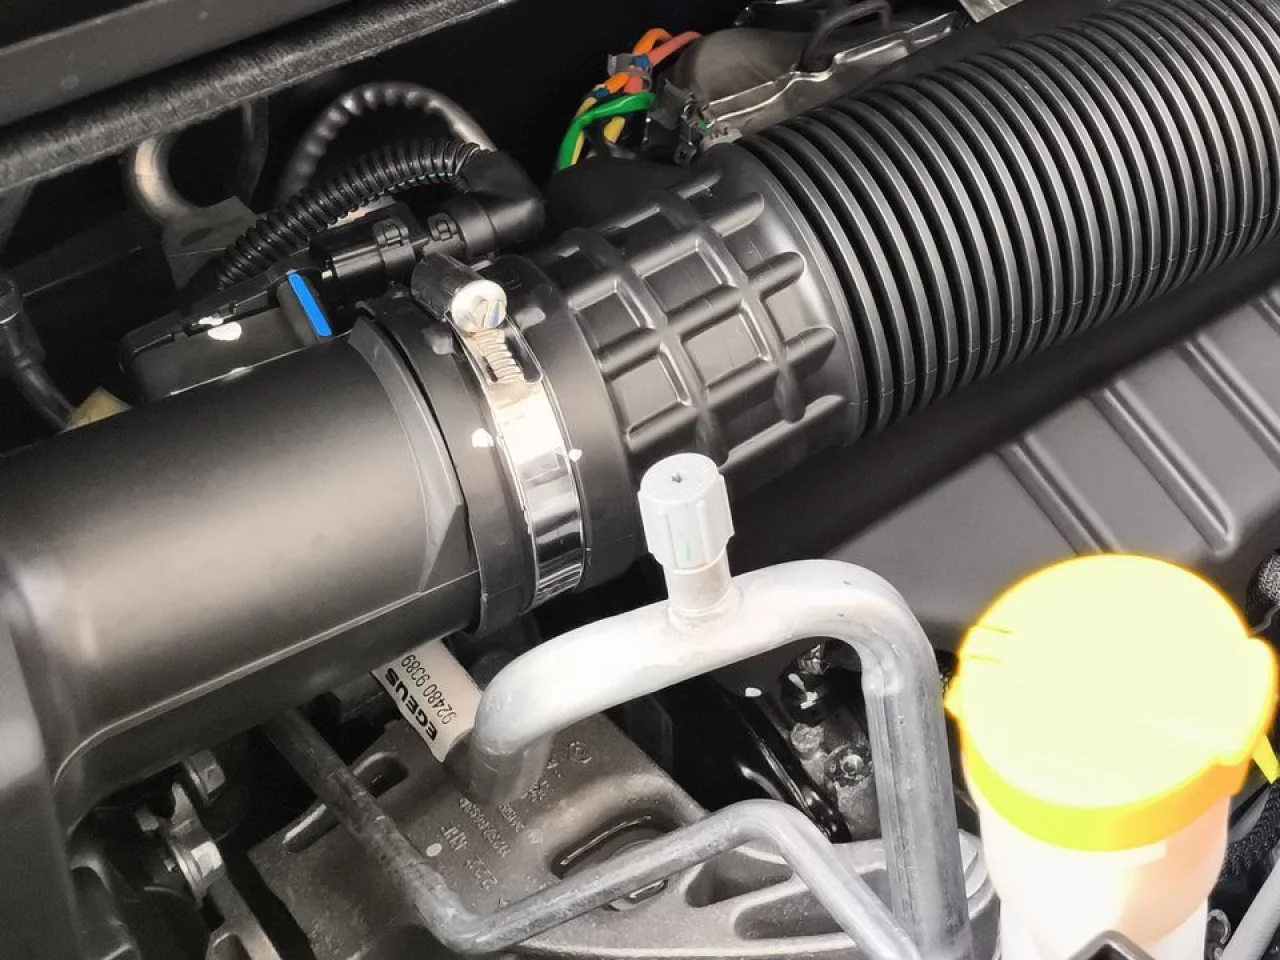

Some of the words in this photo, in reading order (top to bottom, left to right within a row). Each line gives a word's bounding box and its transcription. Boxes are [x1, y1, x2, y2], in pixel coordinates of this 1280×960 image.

[401, 654, 430, 688] 9389
[385, 667, 438, 741] EGEUS
[423, 683, 457, 725] 92480
